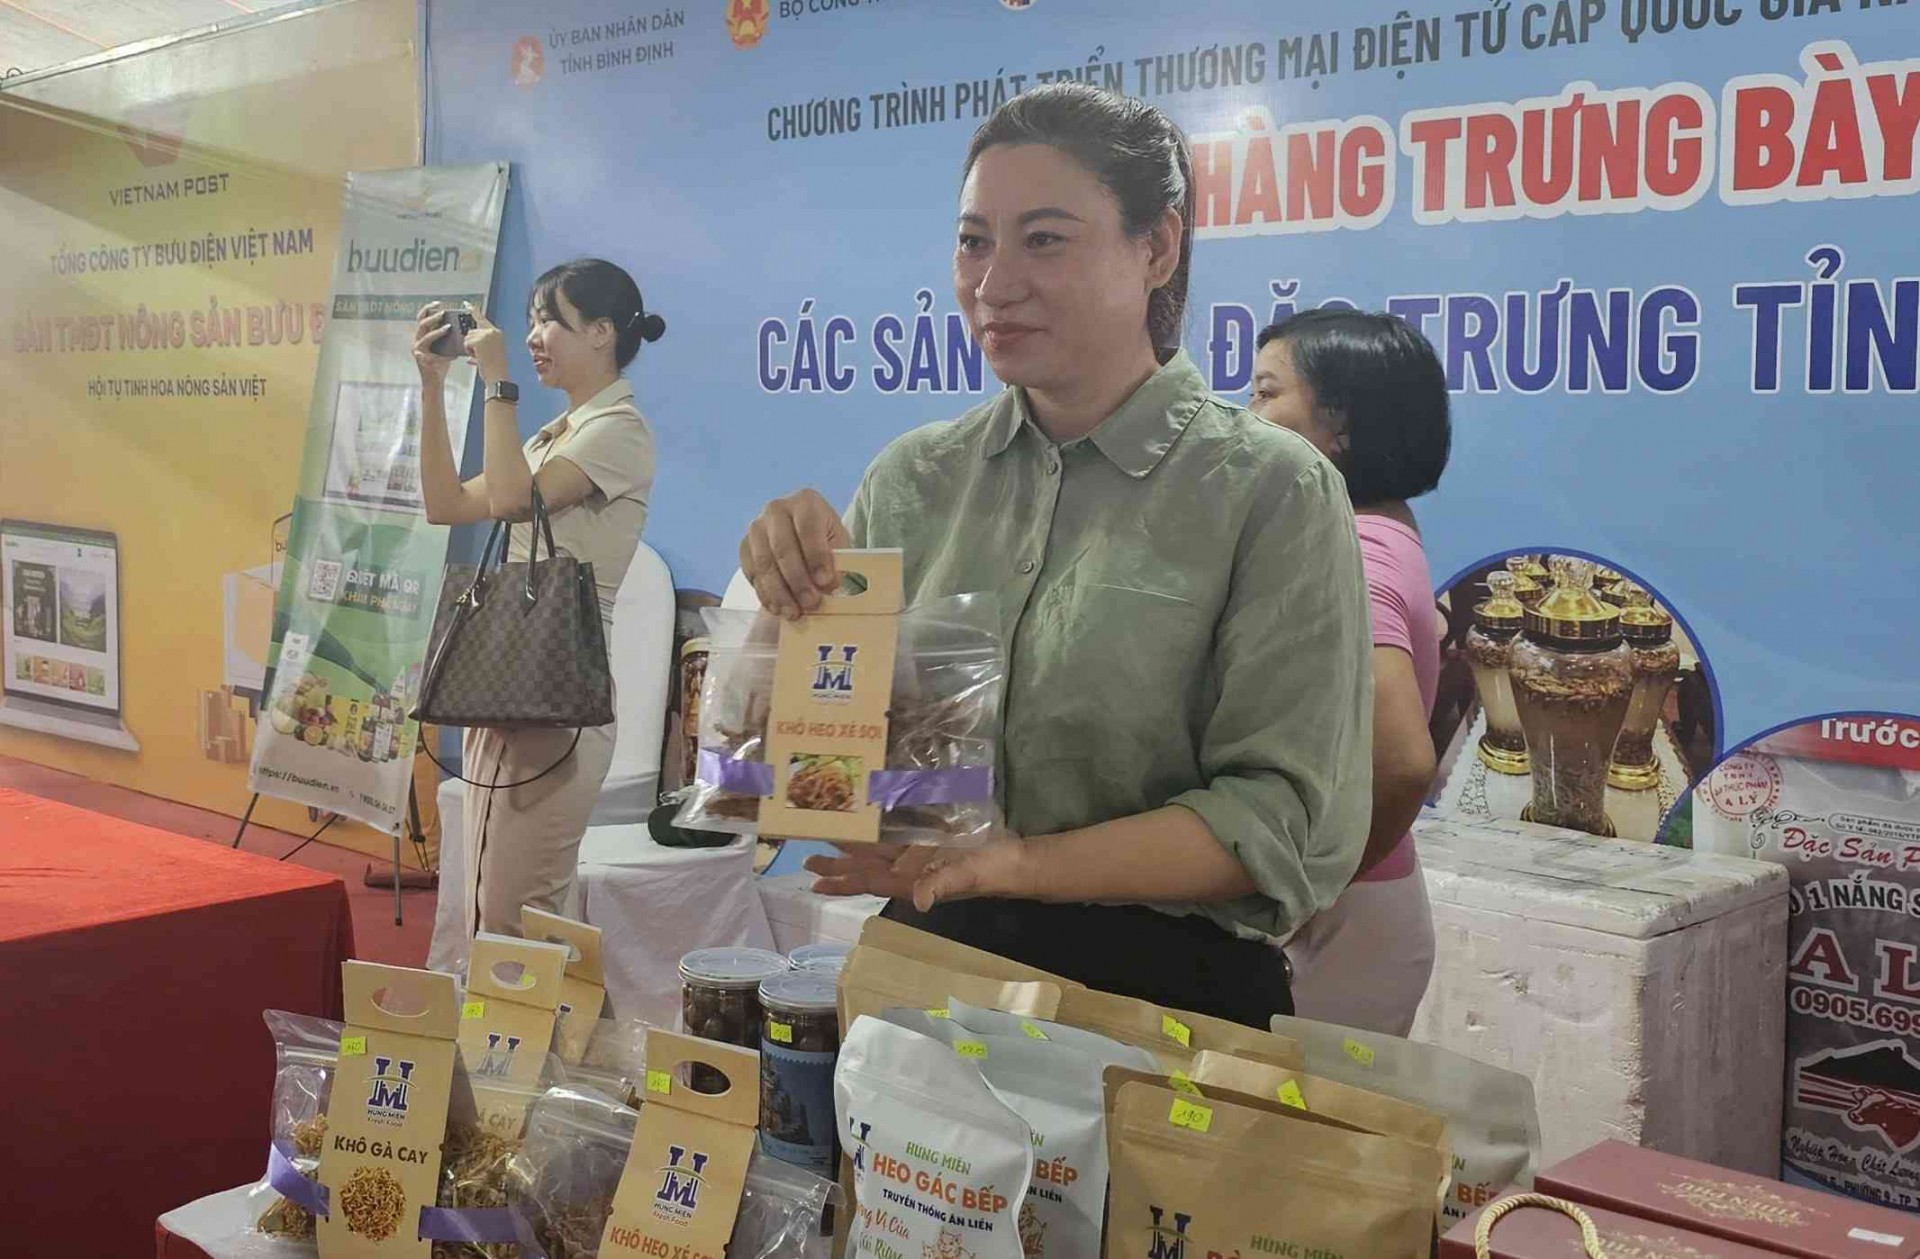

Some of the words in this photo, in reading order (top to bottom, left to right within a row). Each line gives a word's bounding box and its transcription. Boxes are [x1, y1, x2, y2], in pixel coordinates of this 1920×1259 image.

[571, 26, 600, 45] BAN
[605, 15, 647, 40] NHÂN
[651, 7, 685, 31] DÂN
[597, 47, 632, 70] BÌNH
[636, 41, 674, 66] ĐỊNH
[767, 97, 861, 140] CHƯƠNG
[869, 81, 945, 130] TRÌNH
[955, 67, 1027, 119] PHÁT
[1135, 42, 1265, 98] THƯƠNG
[1277, 31, 1339, 90] MẠI
[1353, 10, 1441, 80] ĐIỆN
[1194, 115, 1386, 228] HÀNG
[1411, 92, 1702, 211] TRƯNG
[1733, 52, 1920, 191] BÀY
[110, 182, 179, 206] VIETNAM
[184, 173, 229, 197] POST
[89, 243, 129, 272] CÔNG
[155, 240, 187, 267] BƯU
[190, 232, 227, 270] ĐIỆN
[231, 227, 268, 266] VIỆT
[272, 228, 314, 256] NAM
[189, 295, 242, 348] SẢN
[245, 299, 304, 347] BƯU
[759, 299, 856, 393] CÁC
[872, 289, 984, 393] SẢN
[1736, 247, 1920, 392] TỈN
[151, 378, 174, 397] HOA
[177, 374, 210, 397] NÔNG
[240, 373, 267, 402] VIỆT
[1821, 718, 1920, 748] Trước
[1784, 827, 1831, 857] Đặc
[1839, 837, 1892, 864] Sản
[1833, 875, 1904, 912] NẮNG
[334, 1135, 367, 1154] KHÔ
[371, 1141, 393, 1160] GÀ
[397, 1146, 428, 1165] CAY
[872, 1153, 912, 1184] HEO
[915, 1171, 958, 1205] GÁC
[962, 1184, 1009, 1214] BẾP
[1035, 1155, 1078, 1187] BẾP
[610, 1225, 640, 1250] KHÔ
[642, 1236, 670, 1258] HEO
